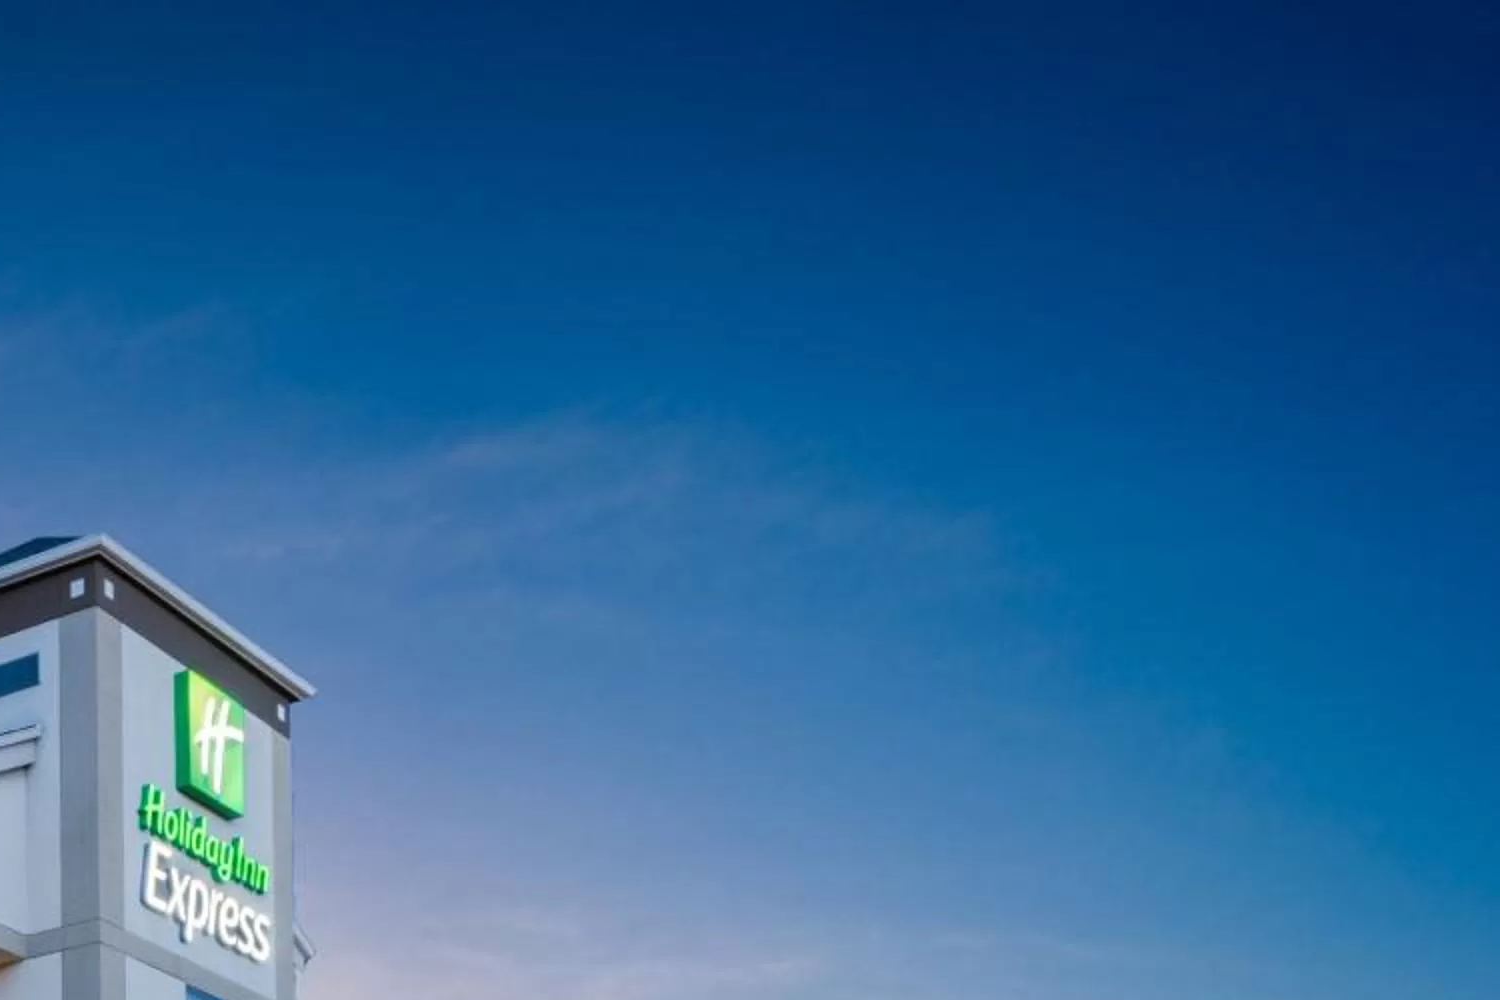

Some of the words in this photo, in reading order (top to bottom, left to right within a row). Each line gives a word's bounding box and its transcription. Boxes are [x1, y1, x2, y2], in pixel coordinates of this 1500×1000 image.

[195, 696, 244, 794] H
[139, 783, 232, 882] Holiday
[233, 836, 269, 894] Inn
[142, 841, 270, 961] Express
